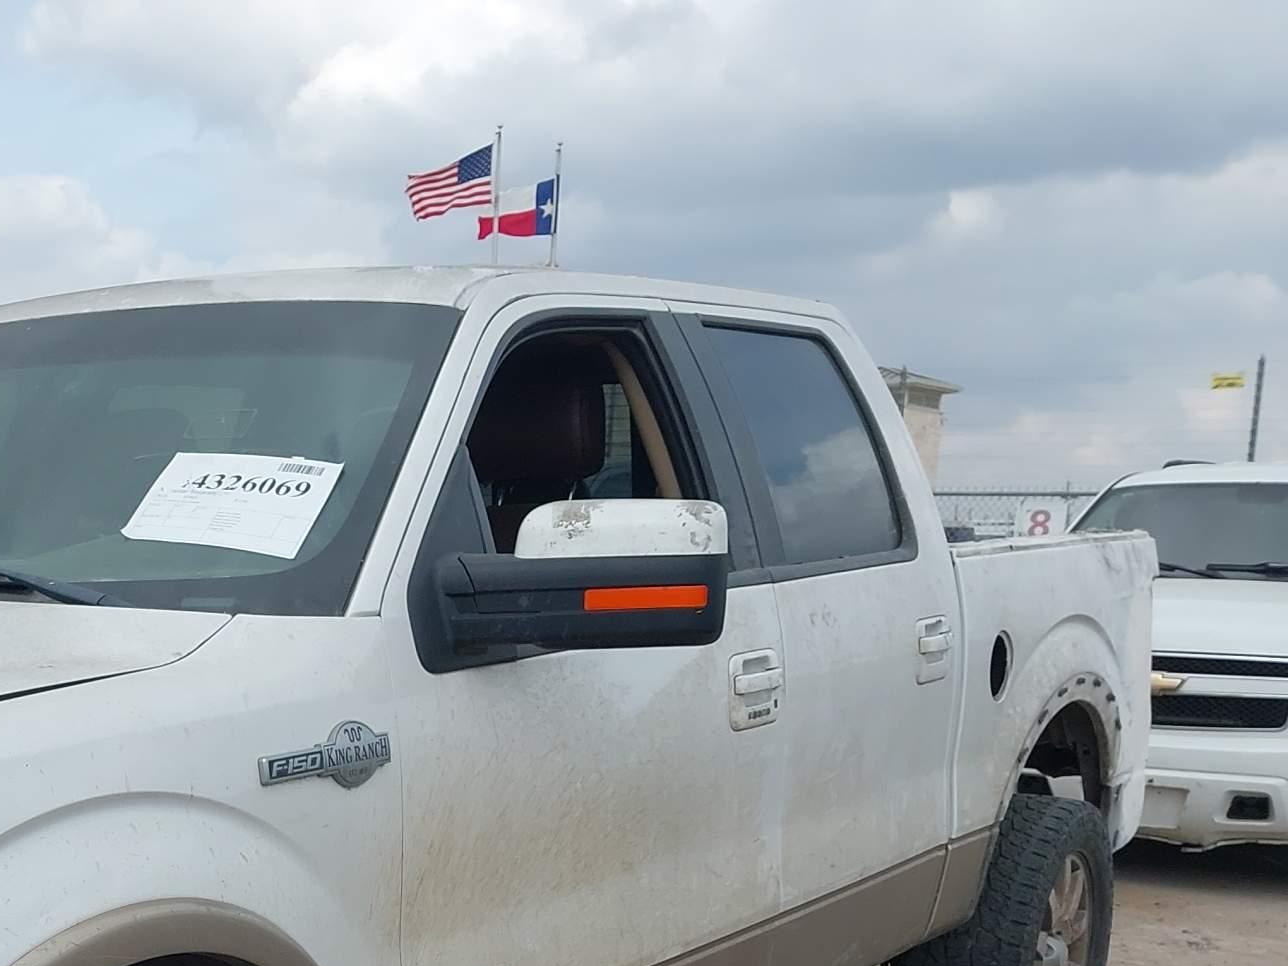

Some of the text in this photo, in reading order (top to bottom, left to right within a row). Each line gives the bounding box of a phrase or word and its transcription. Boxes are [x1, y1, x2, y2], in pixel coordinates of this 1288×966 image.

[1027, 509, 1051, 537] 8
[325, 736, 389, 768] KING RANCH
